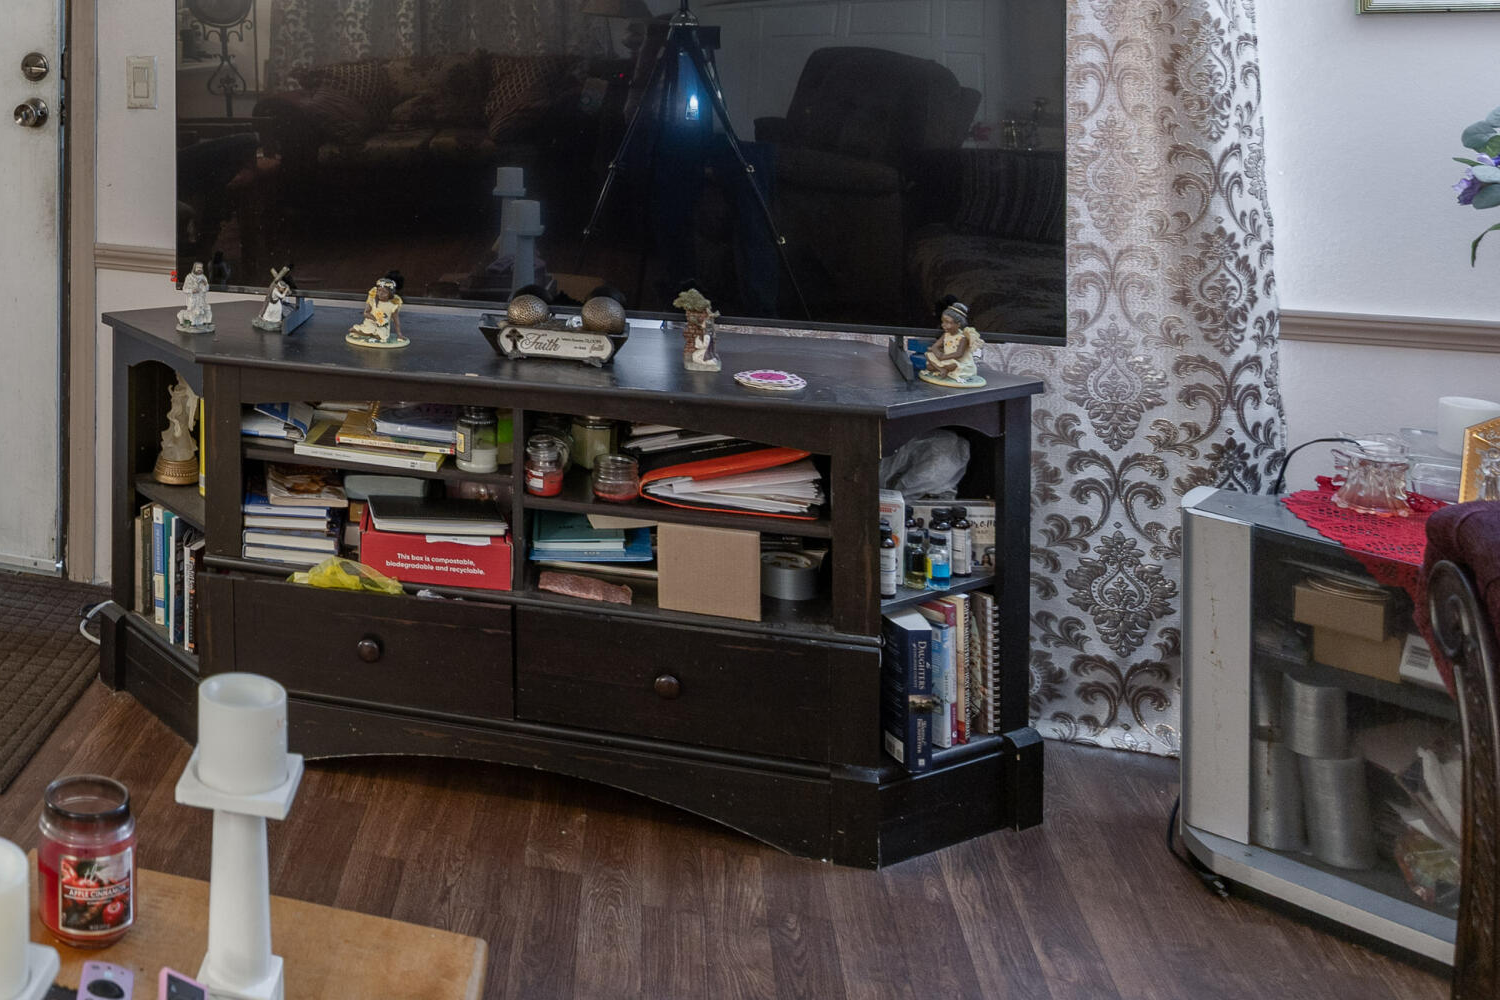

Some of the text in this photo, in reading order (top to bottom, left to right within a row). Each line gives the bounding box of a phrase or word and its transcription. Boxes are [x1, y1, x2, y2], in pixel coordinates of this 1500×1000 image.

[520, 333, 560, 352] Faith
[397, 552, 410, 560] This
[431, 557, 476, 567] compostable,
[385, 560, 434, 571] biodegradable
[449, 566, 485, 575] recyclable.
[917, 641, 927, 690] DAUGHTERS
[68, 883, 127, 898] APPLE CINNAMON
